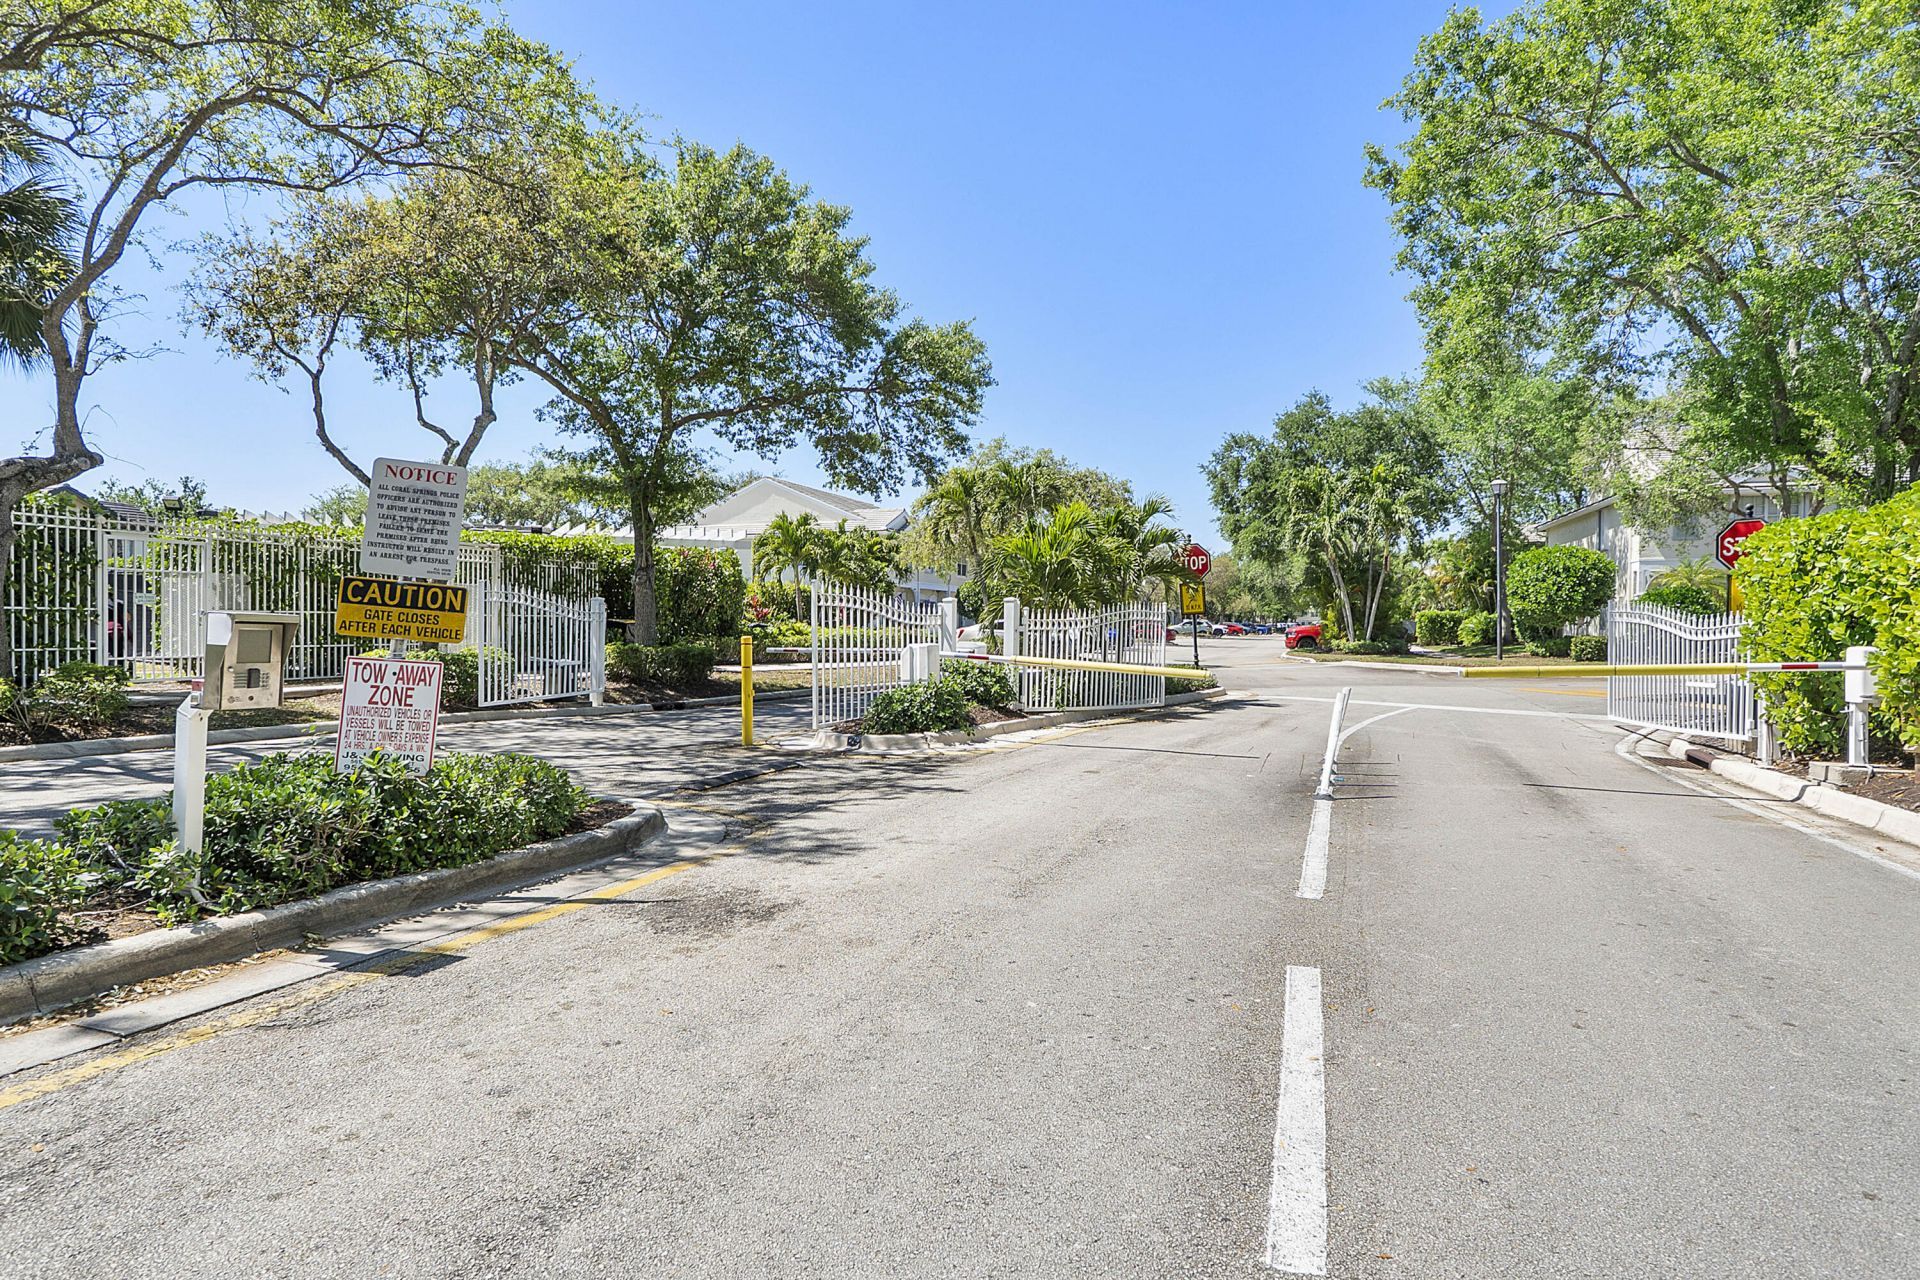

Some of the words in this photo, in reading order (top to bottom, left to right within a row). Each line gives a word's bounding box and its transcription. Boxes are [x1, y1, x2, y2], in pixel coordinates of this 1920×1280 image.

[384, 464, 457, 485] NOTICE
[412, 488, 437, 496] SPRINGS
[440, 491, 460, 499] POLICE
[377, 494, 405, 502] OFFICERS
[422, 499, 458, 508] AUTHORIZED
[378, 513, 396, 521] LEAVE
[420, 518, 450, 526] PREMISES
[424, 509, 446, 517] PERSON
[377, 532, 407, 541] PREMISES
[416, 527, 434, 535] LEAVE
[367, 541, 404, 550] INSTRUCTED
[423, 547, 445, 555] RESULT
[380, 552, 404, 560] ARREST
[347, 581, 462, 611] CAUTION
[364, 609, 393, 621] GATE
[398, 612, 440, 625] CLOSES
[339, 620, 376, 633] AFTER
[381, 624, 411, 636] EACH
[416, 626, 461, 640] VEHICLE
[352, 661, 388, 684] TOW
[395, 664, 436, 687] AWAY
[368, 685, 415, 707] ZONE
[347, 705, 391, 718] UNAUTHORIZED
[394, 708, 421, 719] VEHICLES
[423, 709, 432, 720] OR
[346, 717, 375, 729] VESSELS
[378, 719, 393, 730] WILL
[396, 720, 405, 731] BE
[408, 720, 431, 732] TOWED
[344, 729, 351, 740] AT
[353, 730, 376, 741] VEHICLE
[405, 732, 430, 744] EXPENSE
[344, 741, 352, 749] 24
[394, 743, 407, 752] DAYS
[409, 744, 413, 752] A
[376, 752, 424, 762] OING
